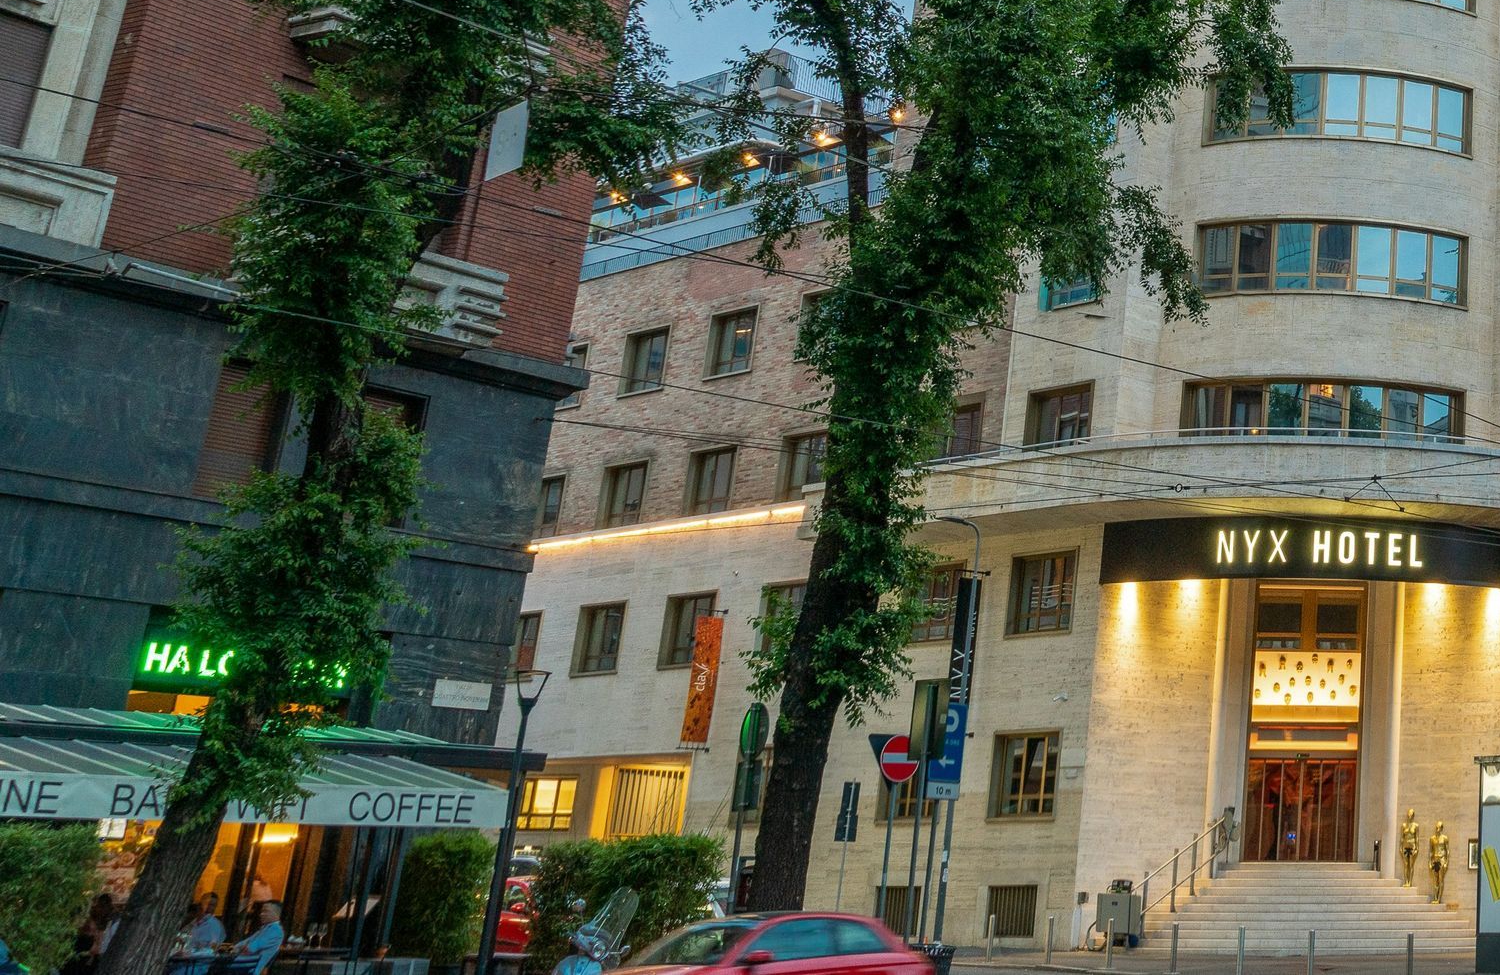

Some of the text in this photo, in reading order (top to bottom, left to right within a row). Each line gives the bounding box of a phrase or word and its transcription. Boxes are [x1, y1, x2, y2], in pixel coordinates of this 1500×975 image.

[1216, 529, 1423, 568] NYX HOTEL
[349, 790, 476, 824] COFFEE
[935, 786, 944, 796] 10
